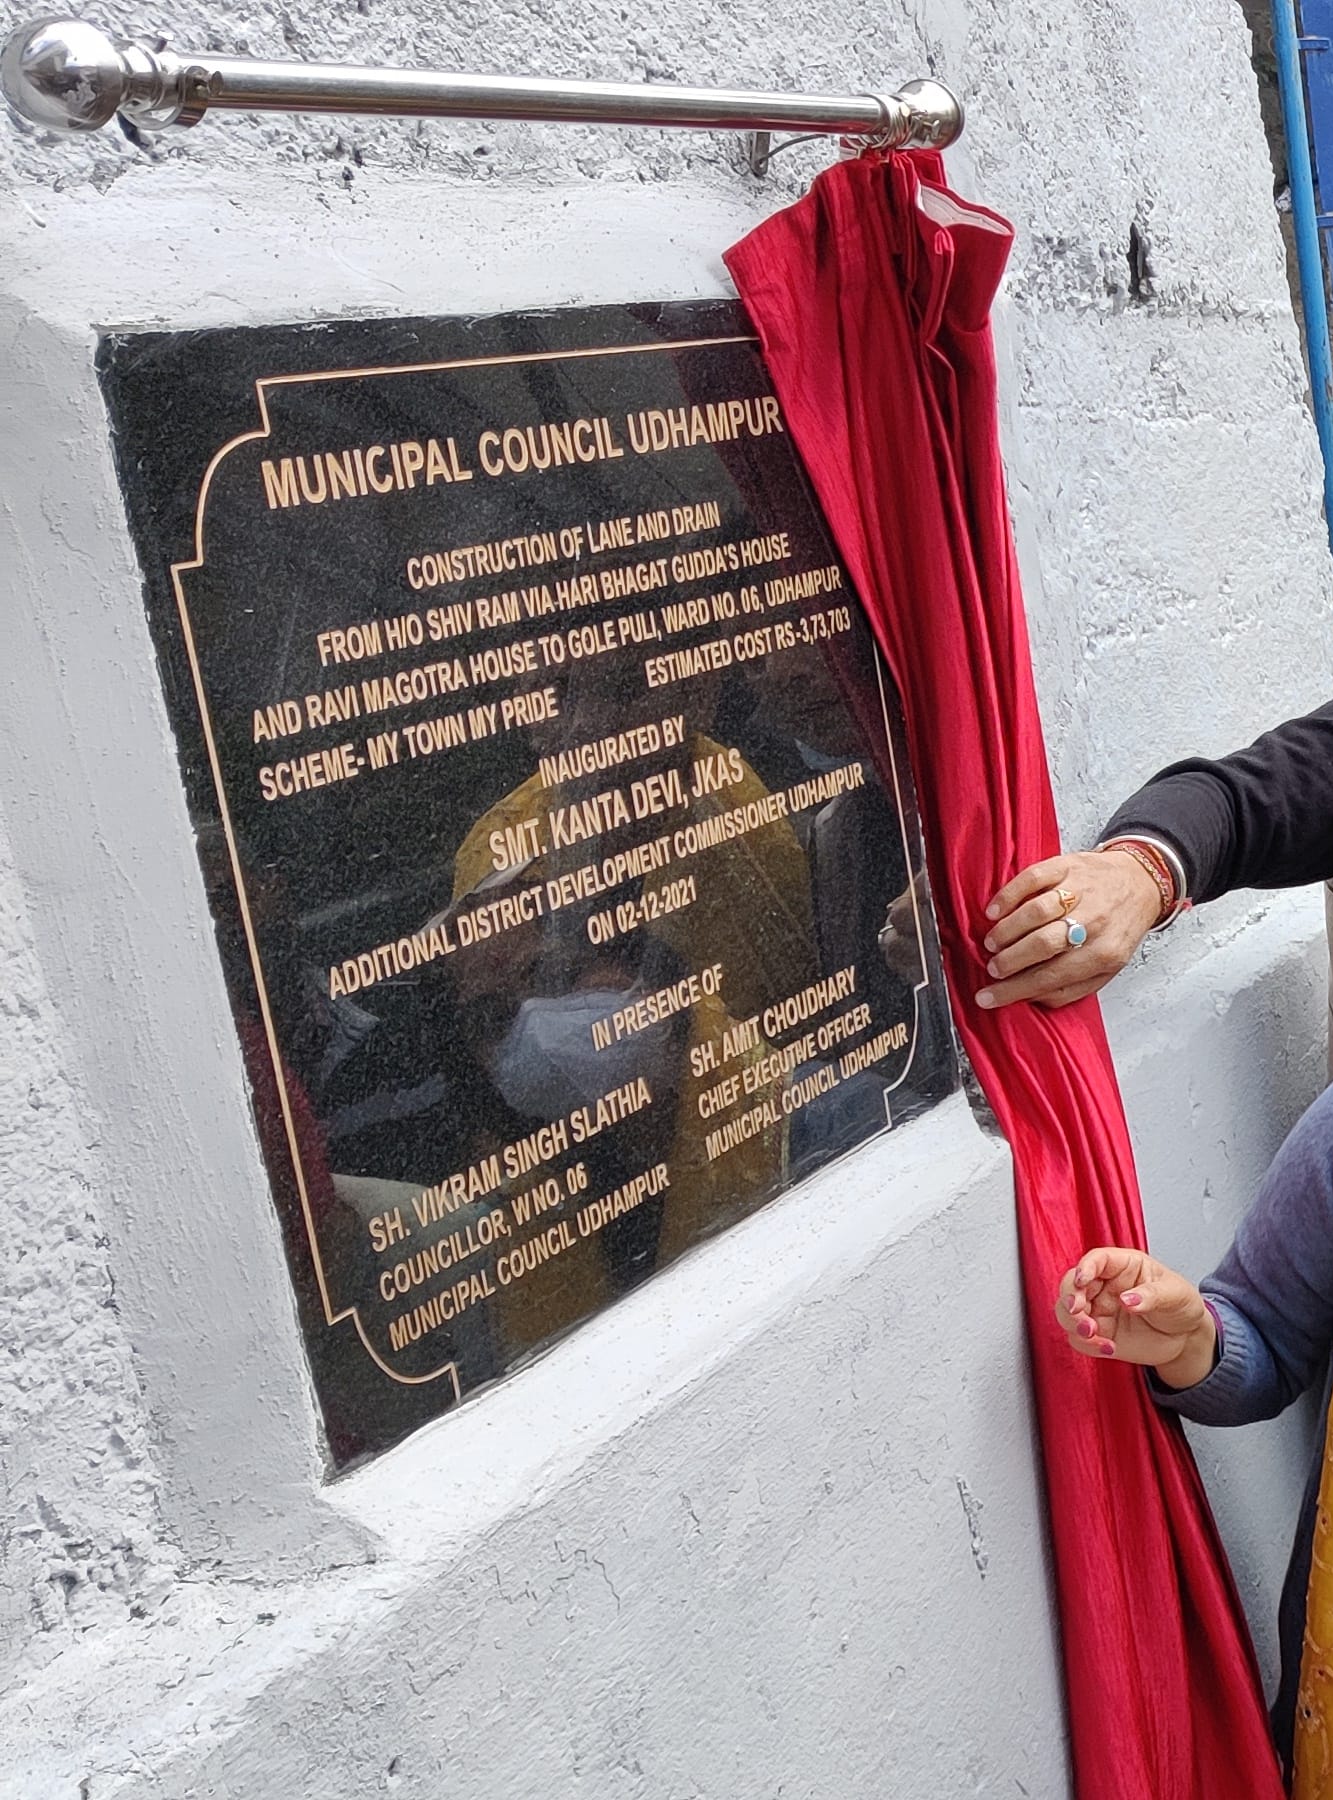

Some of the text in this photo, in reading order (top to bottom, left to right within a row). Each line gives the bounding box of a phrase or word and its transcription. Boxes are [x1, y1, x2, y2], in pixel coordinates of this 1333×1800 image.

[261, 395, 784, 510] MUNICIPAL COUNCIL UDHAMPUR
[317, 621, 383, 667] FROM
[425, 601, 473, 641] SHIV
[476, 591, 522, 629] RAM
[601, 558, 668, 601] BHAGAT
[671, 544, 740, 584] GUDDA'S
[742, 532, 792, 567] HOUSE
[407, 501, 721, 590] CONSTRUCTION OF LANE AND DRAIN
[253, 700, 302, 744] AND
[305, 685, 361, 730] RAVI
[361, 658, 468, 715] MAGOTRA
[469, 639, 538, 685] HOUSE
[538, 633, 565, 667] TO
[568, 621, 618, 659] GOLE
[661, 597, 710, 634] WARD
[711, 591, 740, 622] NO.
[740, 585, 765, 614] 06,
[764, 565, 842, 607] UDHAMPUR
[645, 641, 732, 688] ESTIMATED
[733, 626, 773, 663] COST
[259, 687, 559, 801] SCHEME- MY TOWN MY PRIDE
[538, 715, 684, 788] INAUGURATED BY
[489, 747, 744, 872] SMT. KANTA DEVI, JKAS
[329, 762, 865, 999] ADDITIONAL DISTRICT DEVELOPMENT COMMISSIONER UDHAMPUR
[586, 875, 697, 946] ON 02-12-2021
[591, 962, 724, 1052] IN PRESENCE OF
[690, 965, 857, 1078] SH. AMIT CHOUDHARY
[698, 1003, 873, 1120] CHIEF EXECUTIVE OFFICER
[704, 1022, 909, 1162] MUNICIPAL COUNCIL UDHAMPUR
[368, 1076, 652, 1253] SH. VIKRAM SINGH SLATHIA
[379, 1207, 512, 1302] COUNCILLOR,
[531, 1177, 565, 1216] NO.
[566, 1161, 588, 1196] 06
[388, 1162, 671, 1353] MUNICIPAL COUNCIL UDHAMPUR
